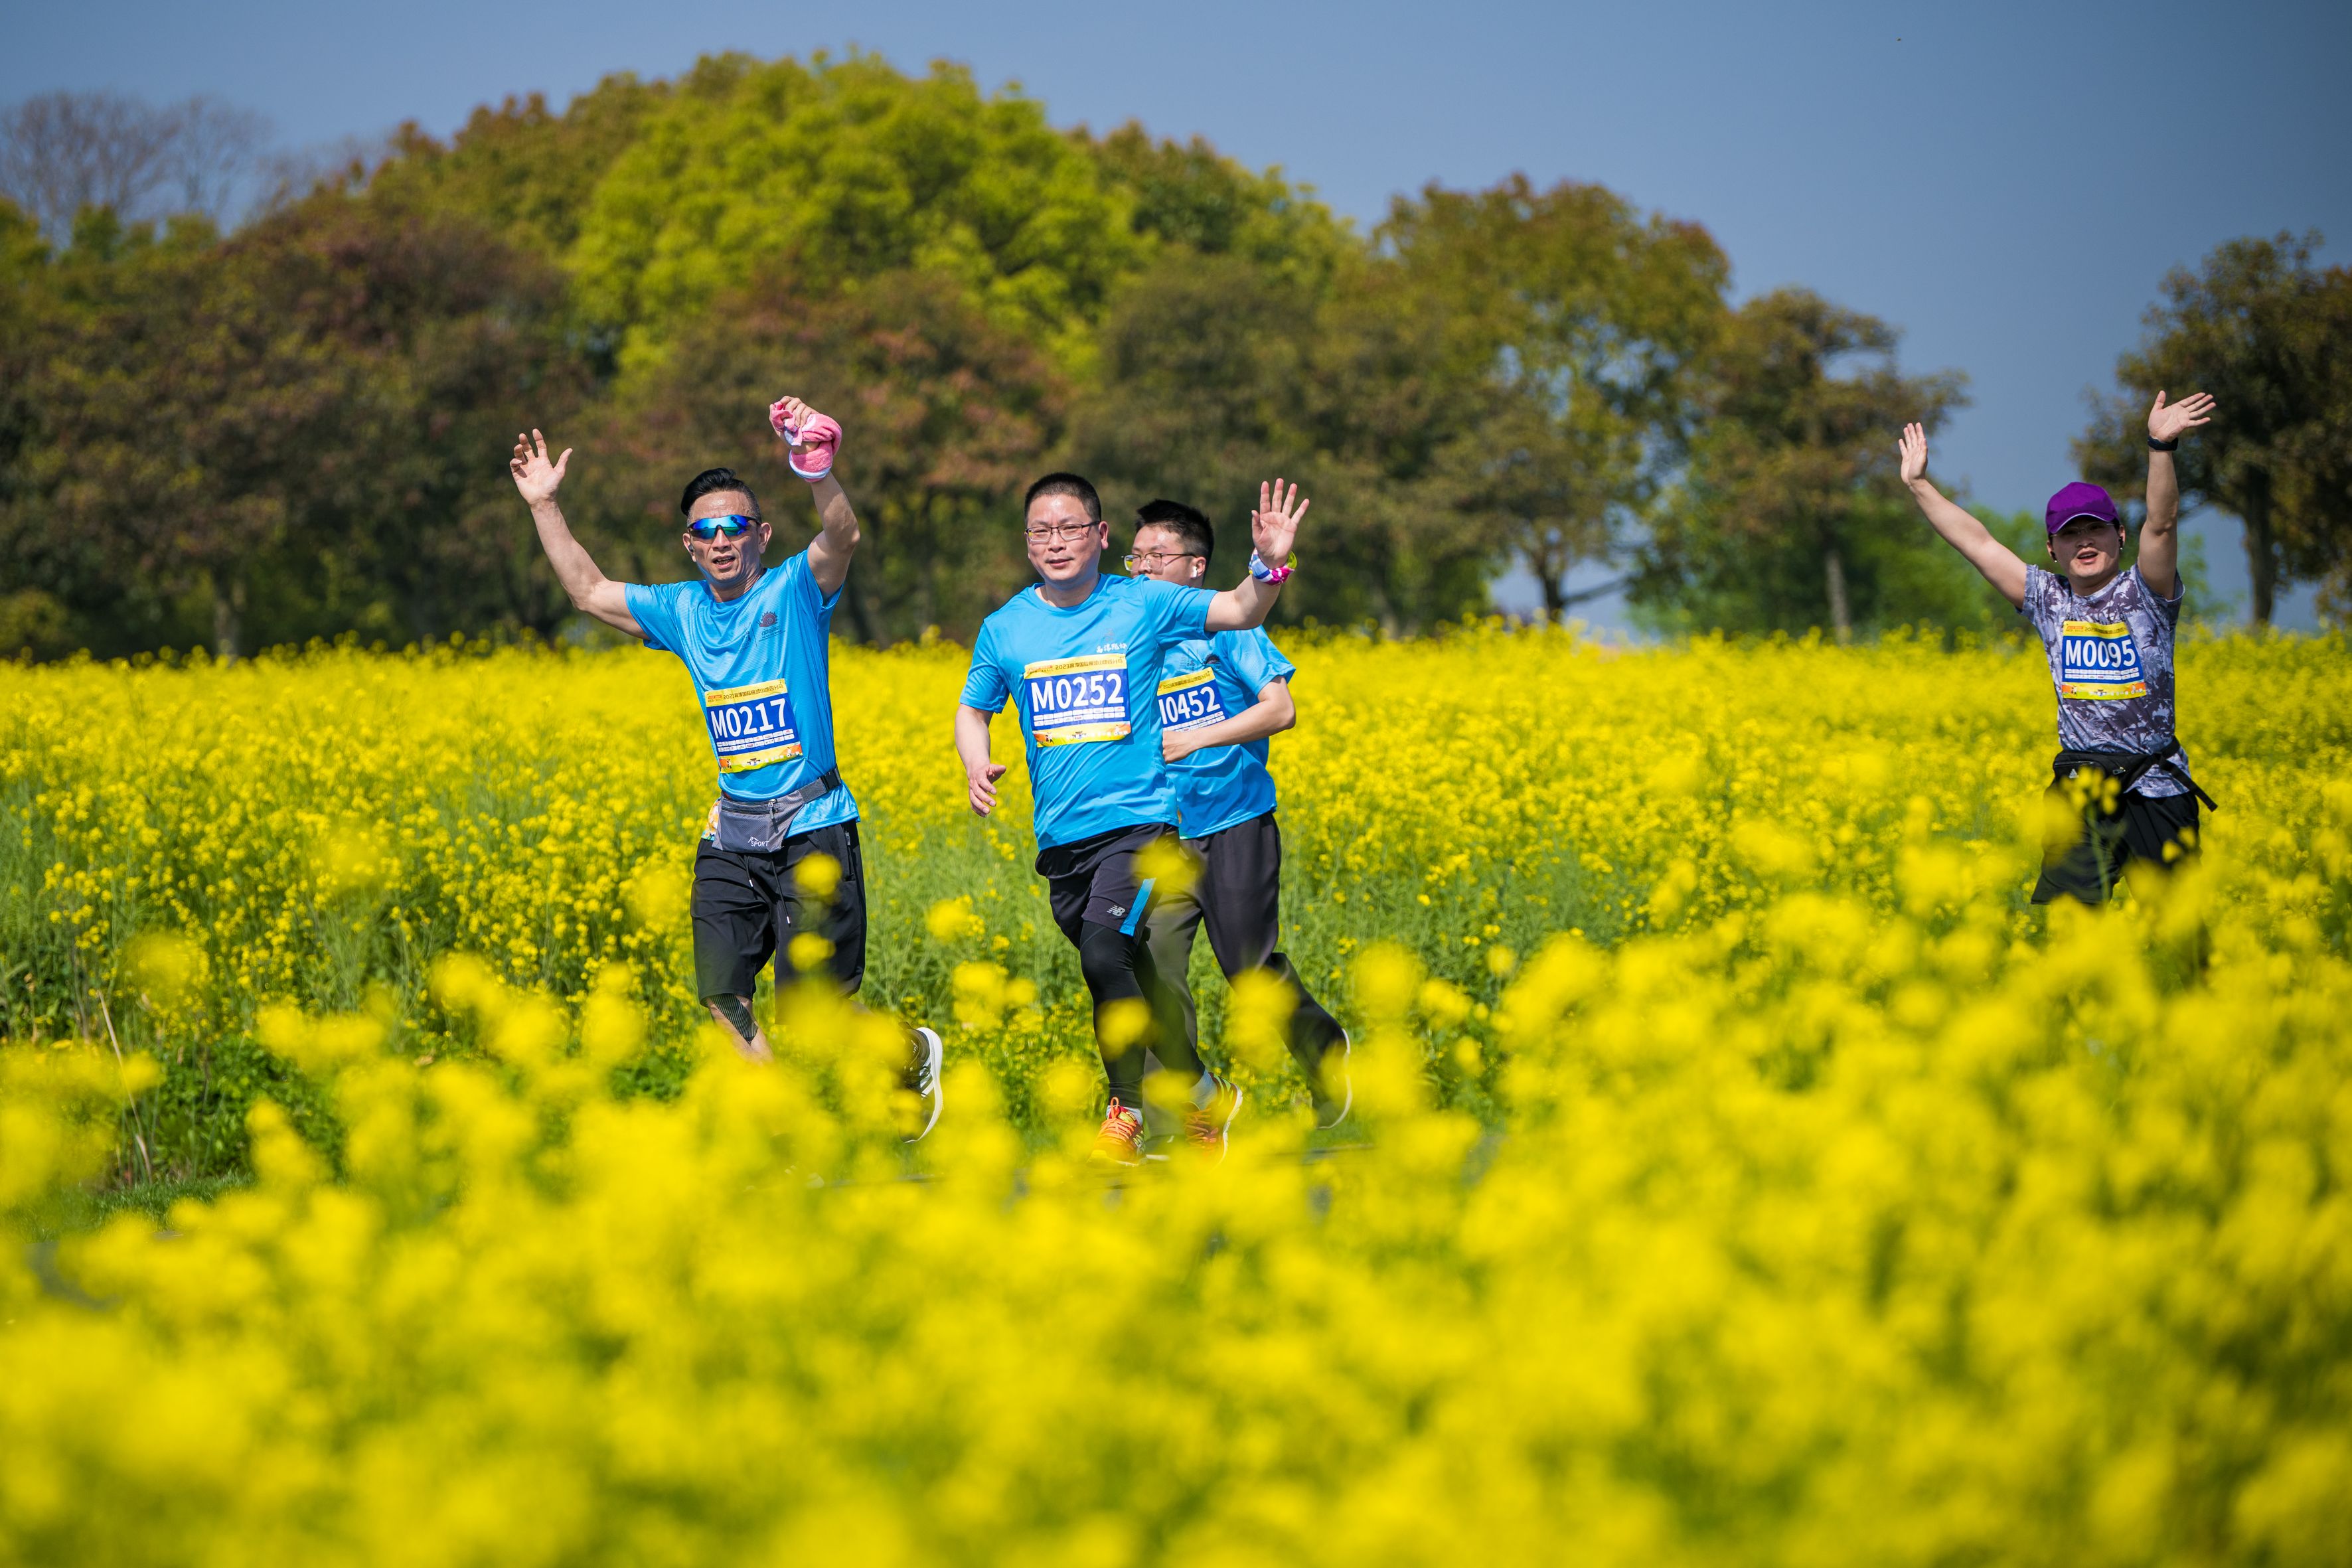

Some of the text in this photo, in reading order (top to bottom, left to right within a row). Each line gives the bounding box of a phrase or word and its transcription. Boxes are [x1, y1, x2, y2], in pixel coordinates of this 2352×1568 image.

[2066, 639, 2136, 668] M0095
[1031, 673, 1123, 712] M0252
[710, 698, 786, 739] M0217
